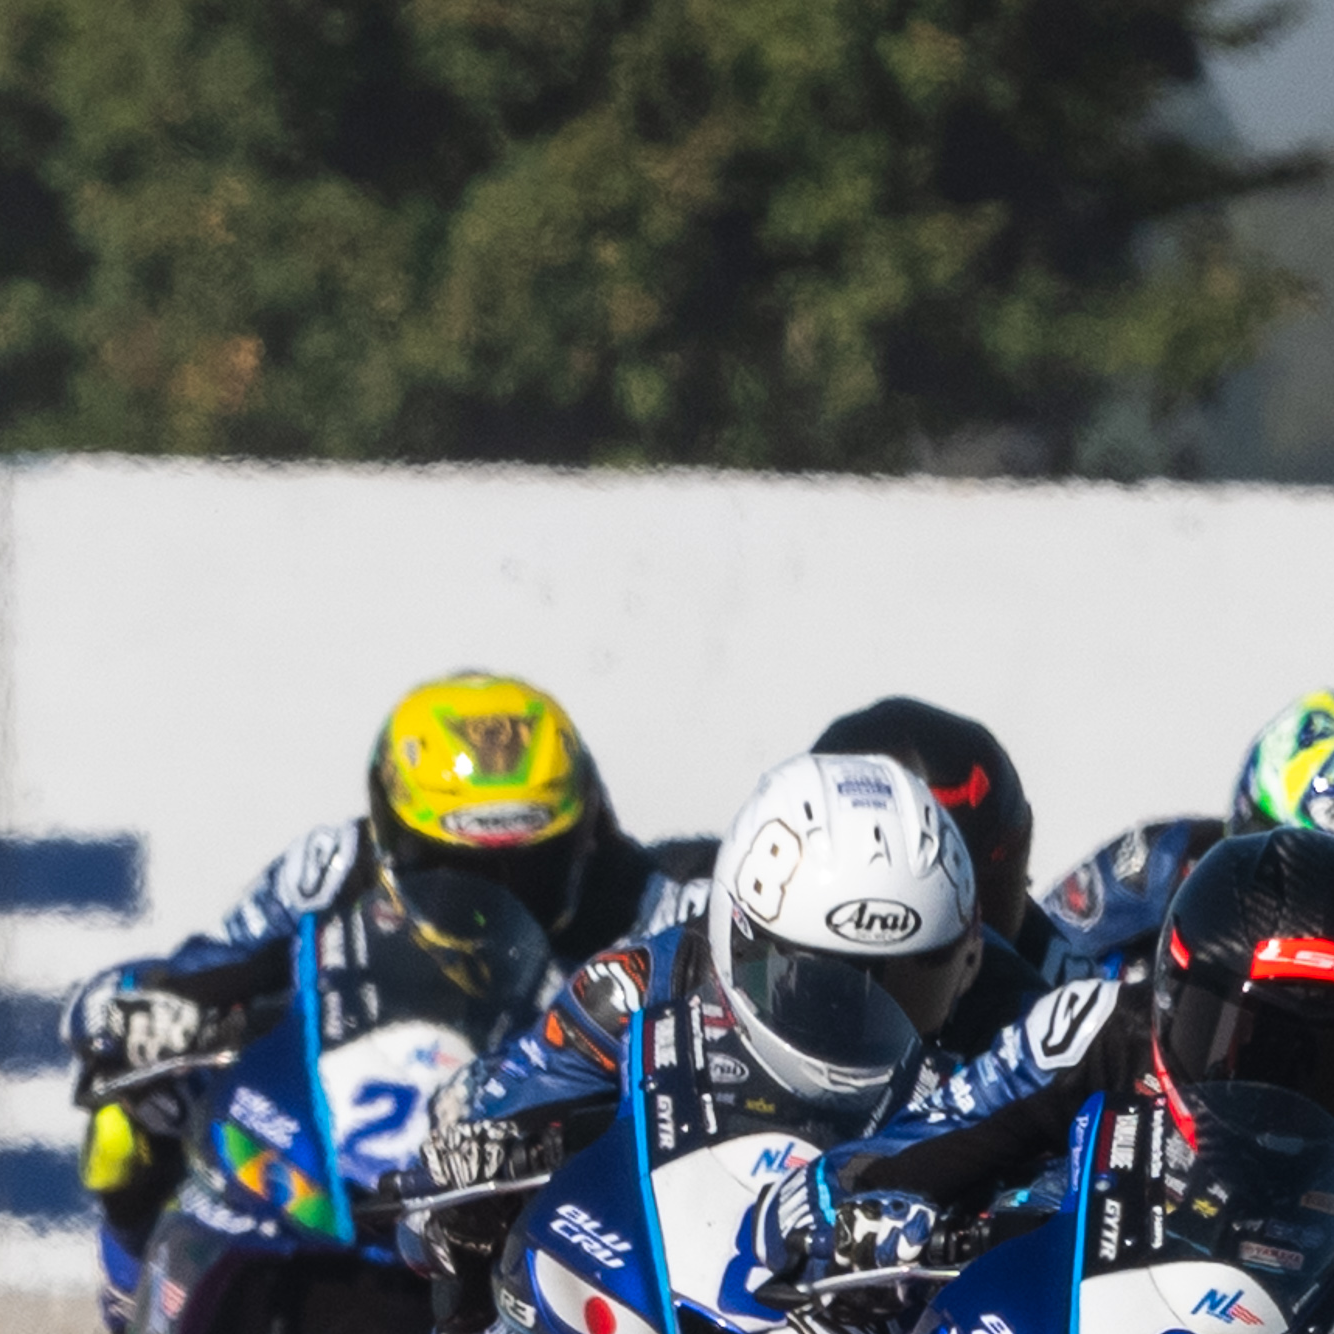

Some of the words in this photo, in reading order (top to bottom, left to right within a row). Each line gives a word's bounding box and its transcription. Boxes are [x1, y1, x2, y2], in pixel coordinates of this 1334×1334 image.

[833, 902, 911, 932] Arai
[549, 1217, 625, 1270] CRU
[555, 1203, 634, 1254] BLU
[1099, 1199, 1122, 1262] GYTR
